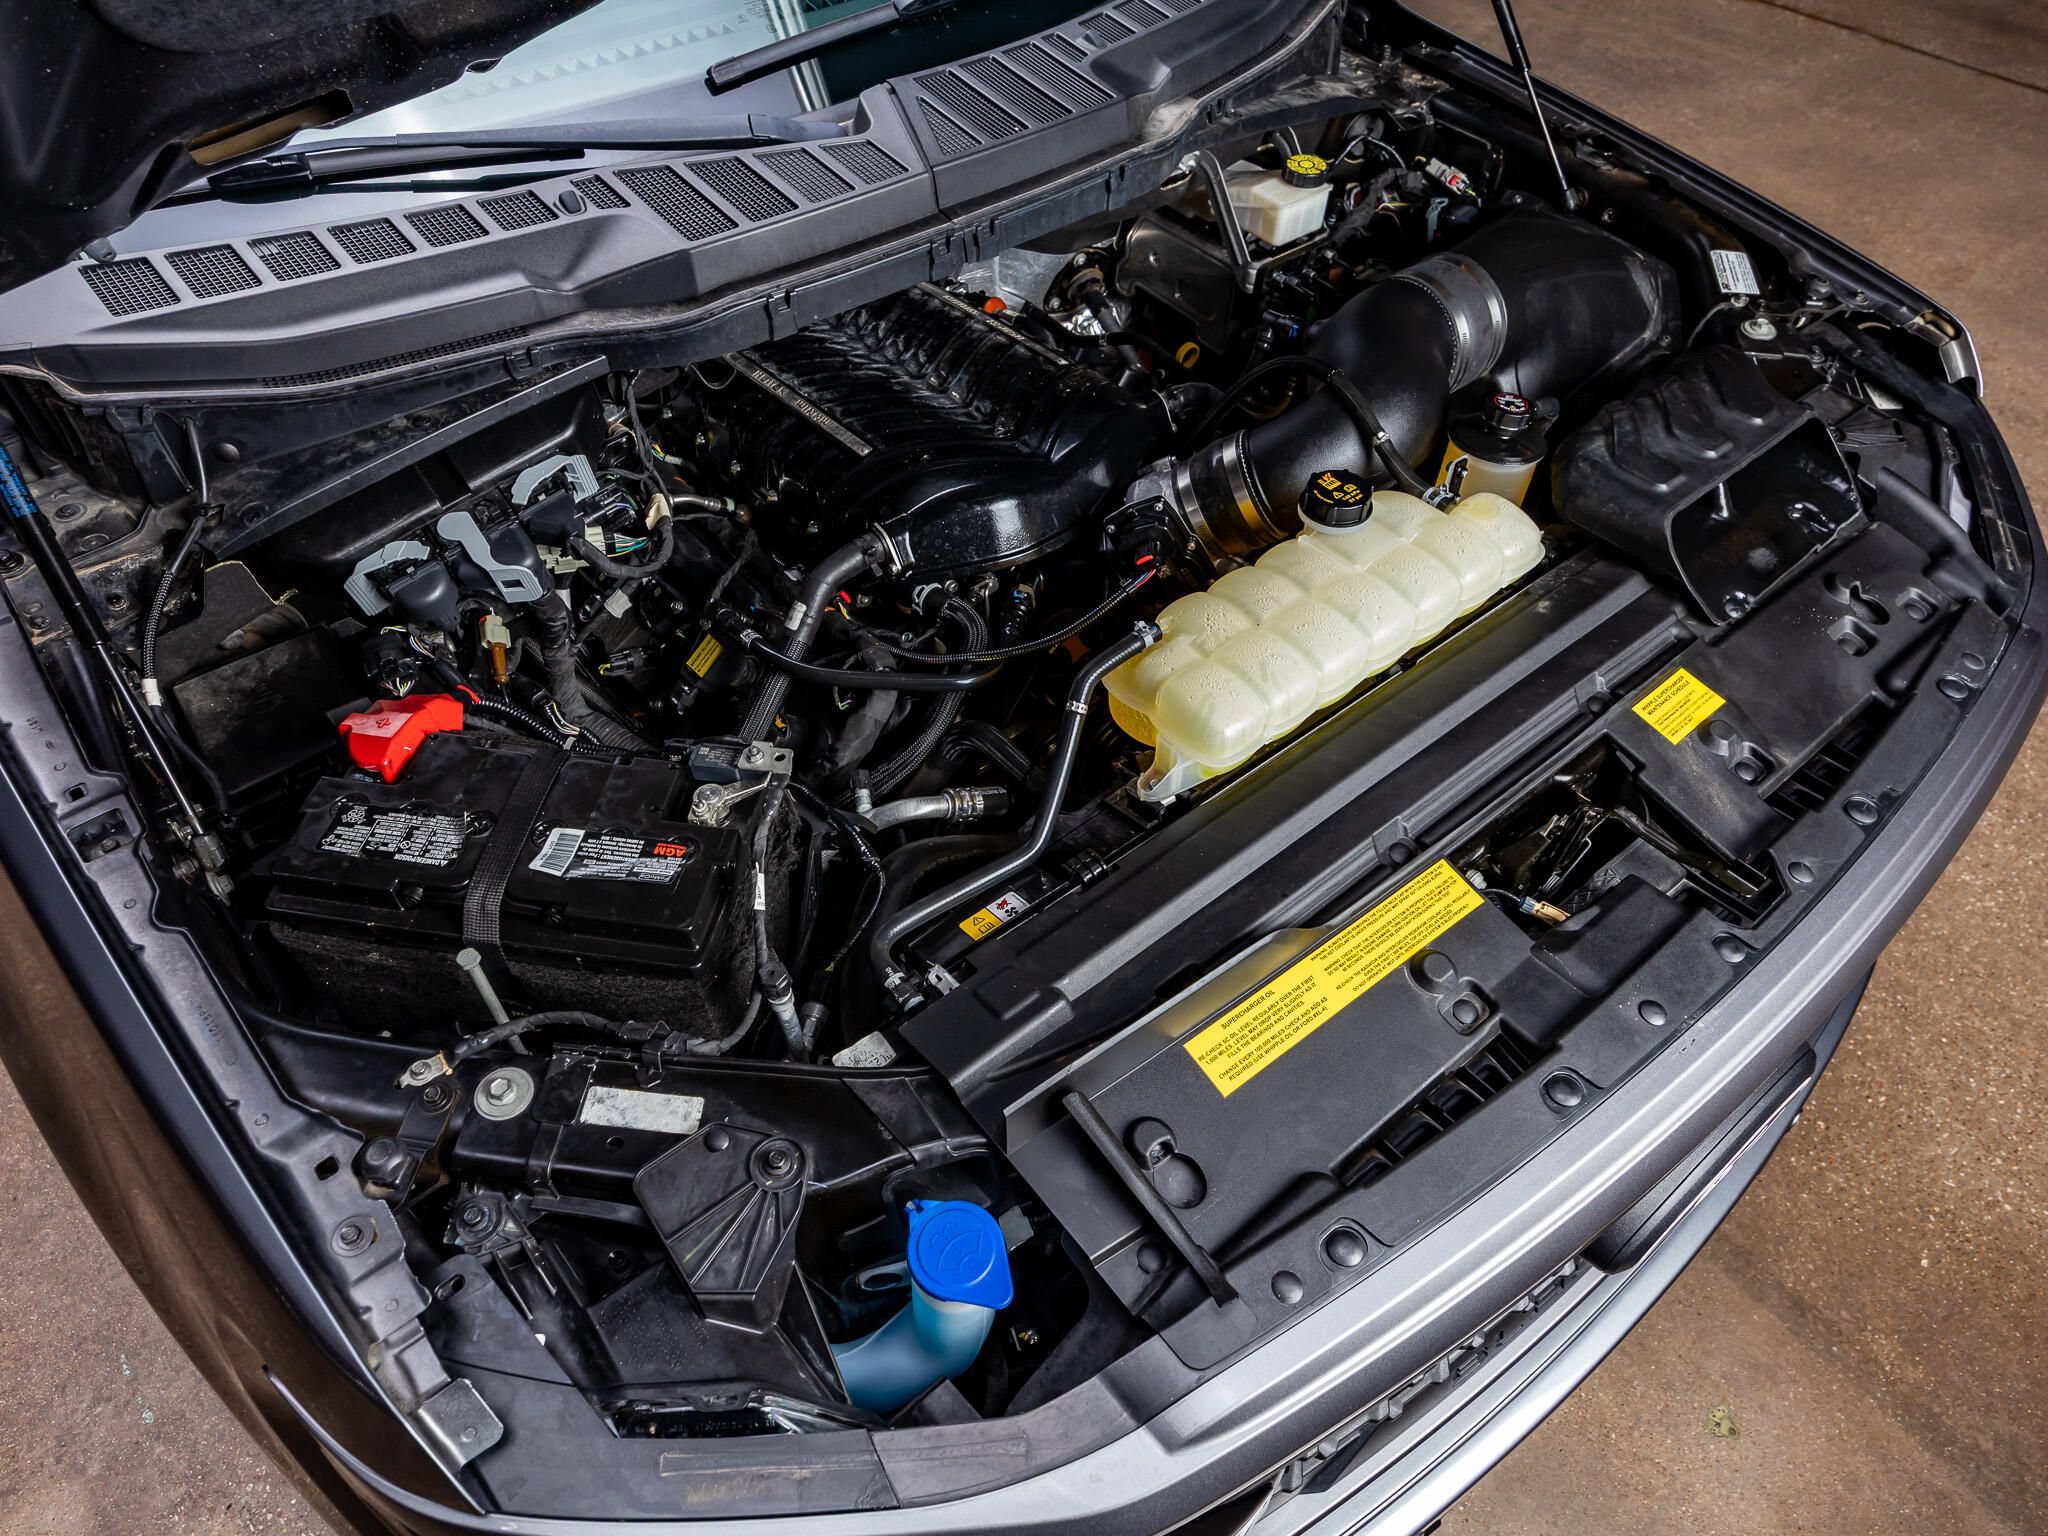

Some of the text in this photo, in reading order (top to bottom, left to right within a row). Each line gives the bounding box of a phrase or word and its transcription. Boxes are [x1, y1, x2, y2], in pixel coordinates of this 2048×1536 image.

[1646, 694, 1672, 715] MAINTENANCE
[1669, 679, 1690, 696] SCHEDULE
[1655, 674, 1685, 699] SUPERCHARGER
[394, 854, 440, 865] DANGER/POISON
[653, 846, 686, 858] AGM
[641, 873, 669, 881] FoMoCo
[1220, 988, 1275, 1030] SUPERCHARGER OIL
[1228, 1030, 1239, 1039] OIL
[1236, 1019, 1253, 1033] LEVEL
[1251, 999, 1280, 1023] REGULARLY
[1278, 990, 1293, 1003] OVER
[1290, 983, 1302, 994] THE
[1300, 974, 1315, 987] FIRST
[1232, 1031, 1249, 1046] LEVEL
[1247, 1024, 1259, 1035] MAY
[1256, 1014, 1273, 1027] DROP
[1270, 1005, 1285, 1017] VERY
[1282, 989, 1306, 1008] SLIGHTLY
[1303, 985, 1313, 993] AS
[1217, 1061, 1239, 1080] CHANGE
[1237, 1050, 1255, 1065] EVERY
[1269, 1027, 1286, 1041] MILES
[1283, 1015, 1302, 1031] CHECK
[1299, 1008, 1312, 1019] AND
[1309, 1001, 1322, 1012] ADD
[1319, 996, 1328, 1004] AS
[1226, 1046, 1242, 1059] FILLS
[1240, 1039, 1251, 1049] THE
[1249, 1021, 1275, 1042] BEARINGS
[1272, 1014, 1285, 1025] AND
[1227, 1060, 1254, 1081] REQUIRED
[1263, 1036, 1285, 1055] WHIPPLE
[1283, 1030, 1293, 1040] OIL
[1291, 1025, 1301, 1034] OR
[1298, 1015, 1314, 1028] FORD
